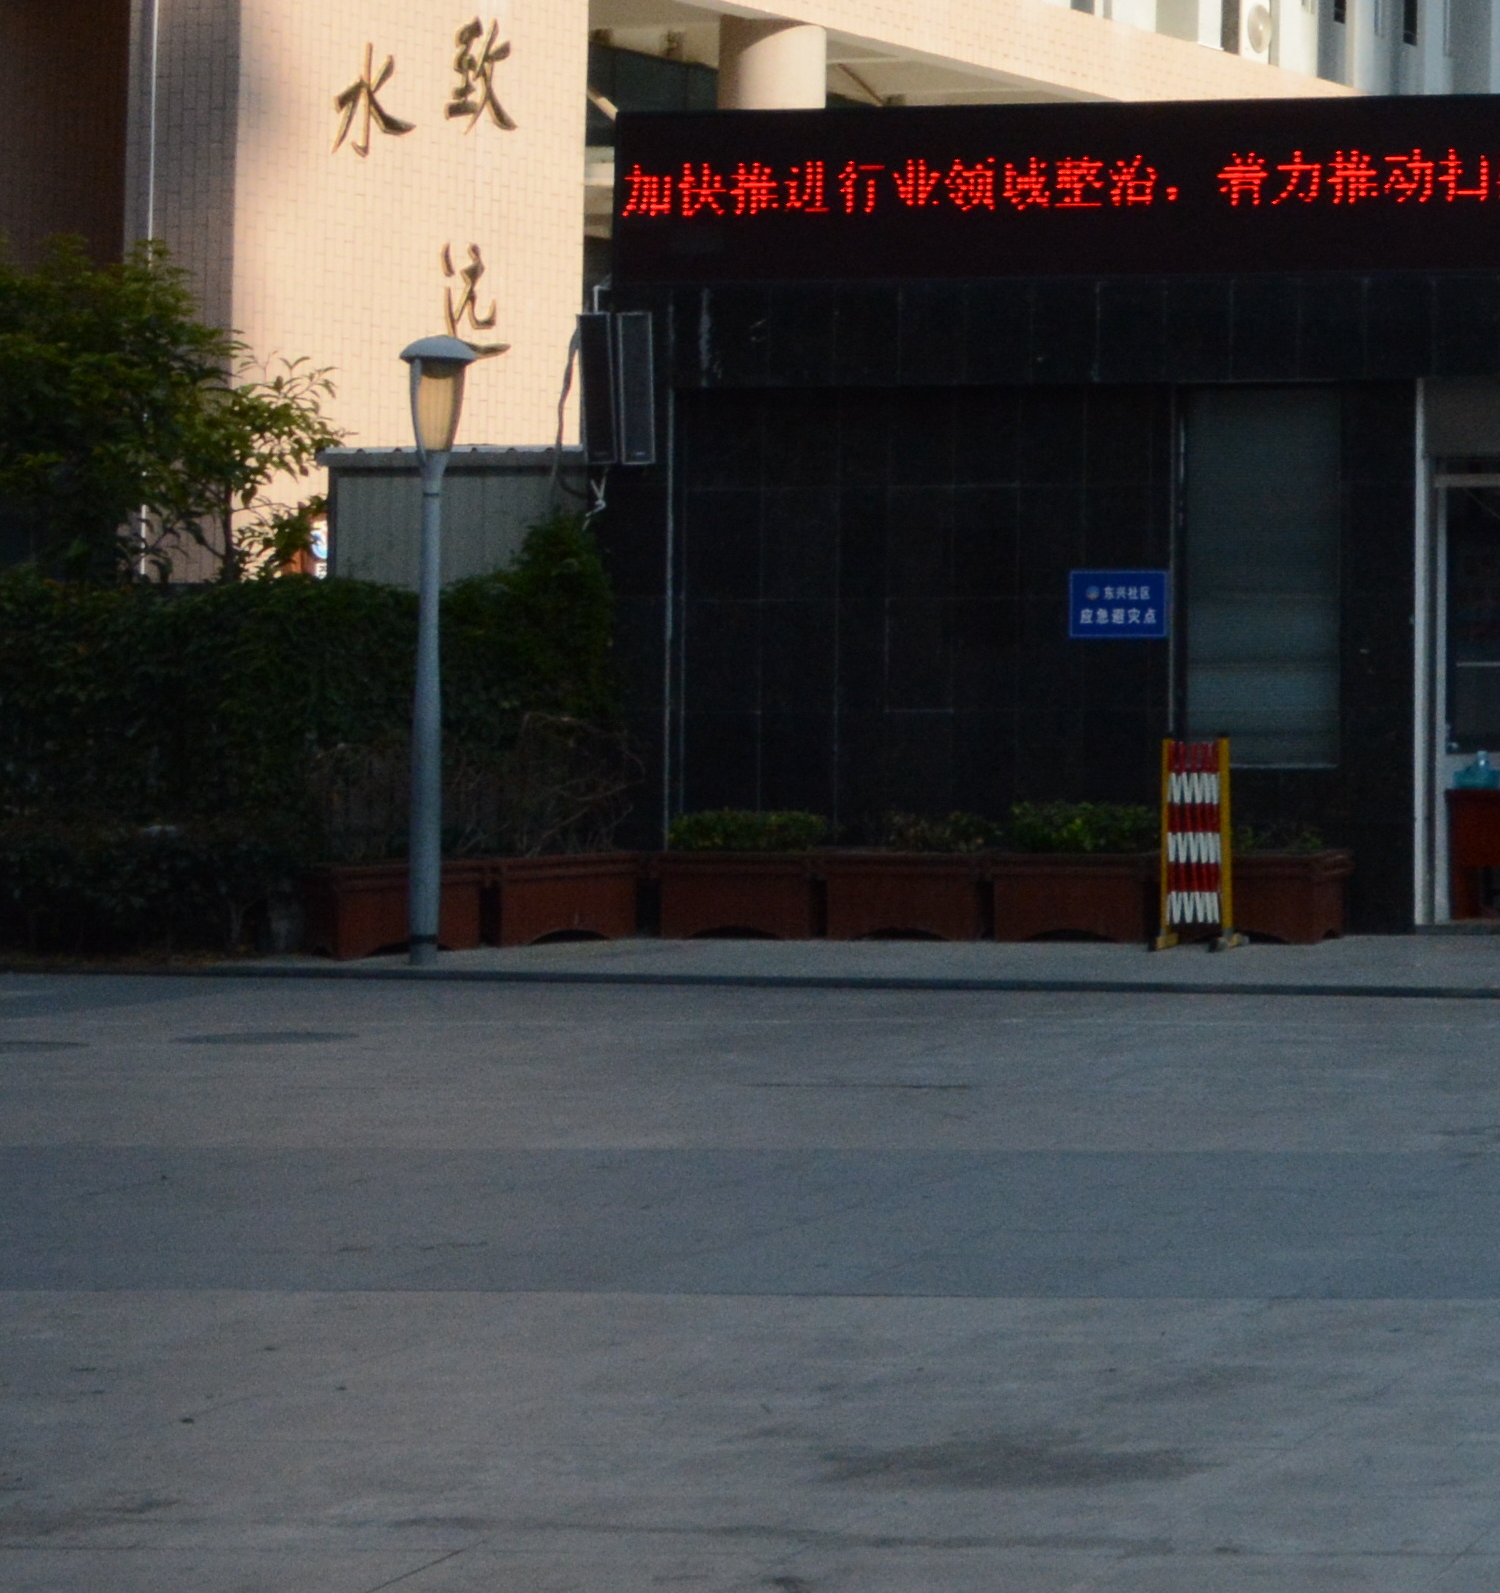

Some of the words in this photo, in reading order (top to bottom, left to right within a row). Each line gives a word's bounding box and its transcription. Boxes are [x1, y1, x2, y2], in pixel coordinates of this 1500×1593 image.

[1079, 608, 1158, 625] 应急避灾点
